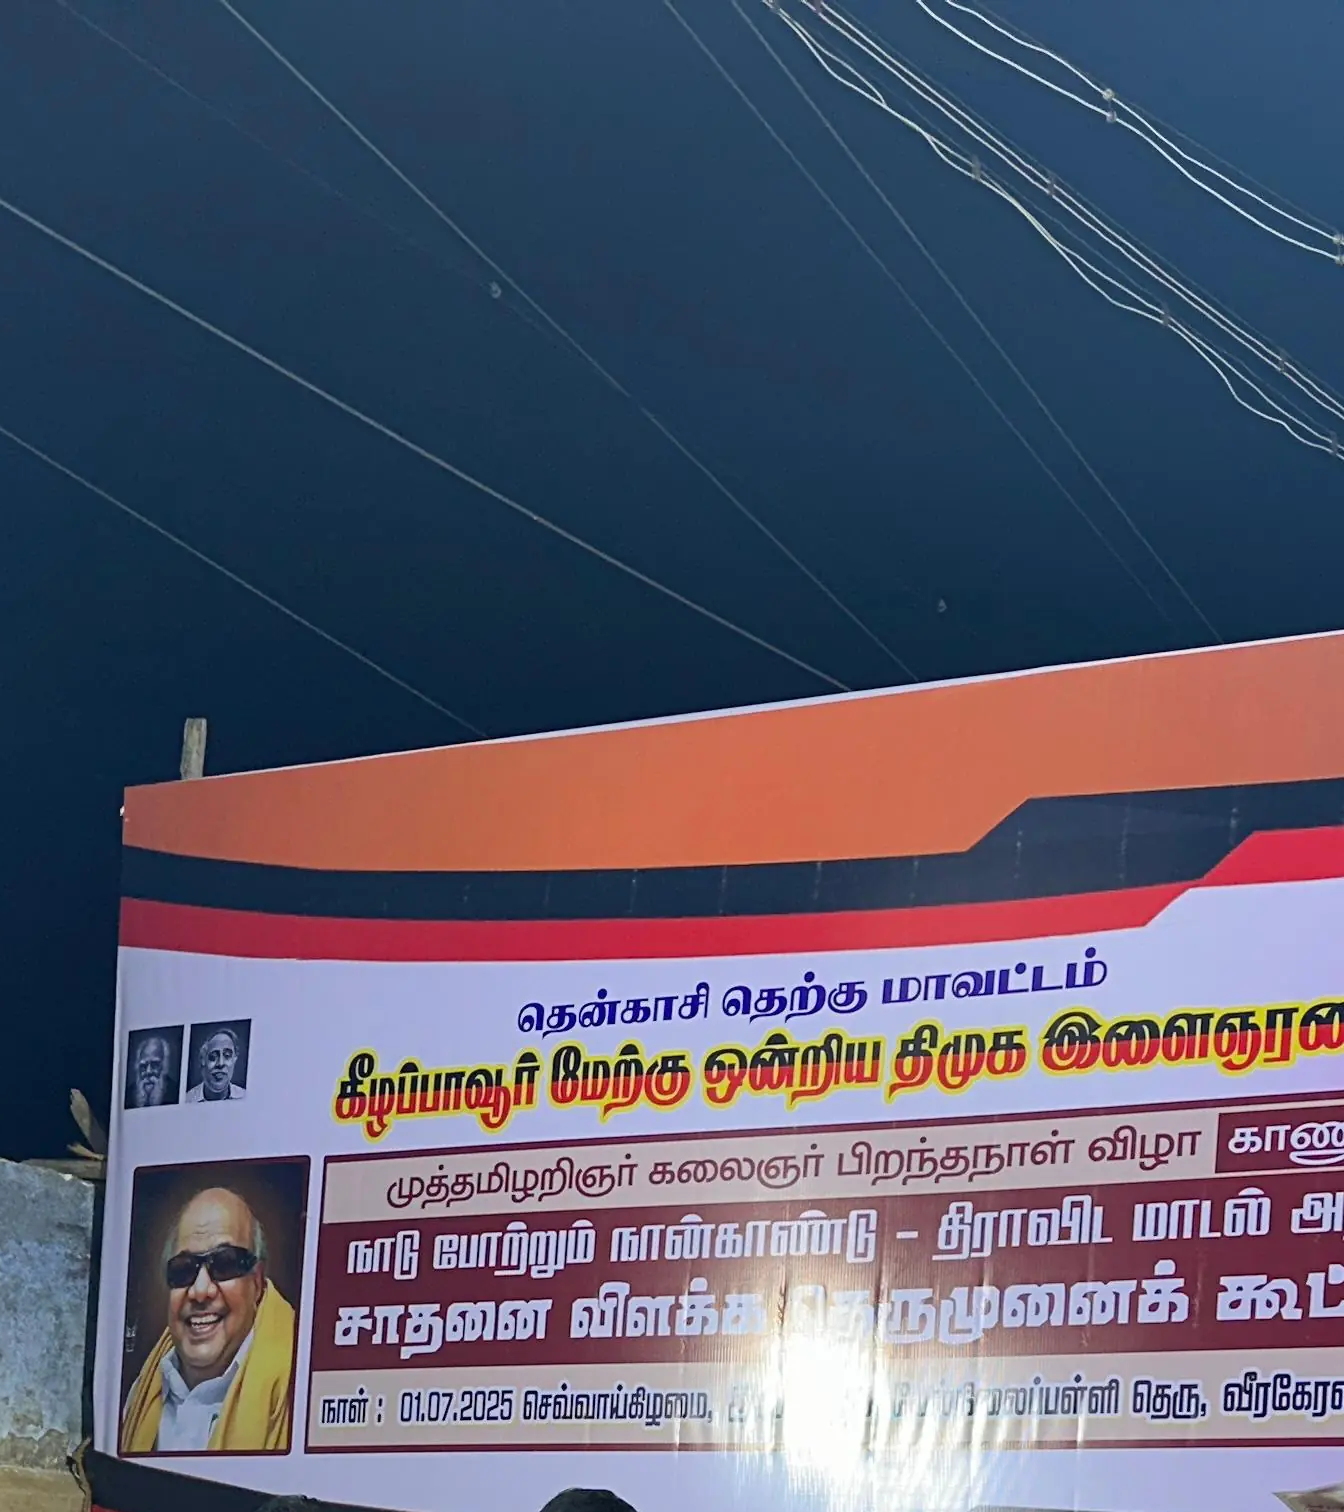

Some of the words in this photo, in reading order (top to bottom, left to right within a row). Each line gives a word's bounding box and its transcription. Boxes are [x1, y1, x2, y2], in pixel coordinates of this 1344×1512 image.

[518, 982, 710, 1039] தென்காசி
[721, 970, 865, 1025] தெற்கு
[882, 947, 1107, 1005] மாவட்டம்
[334, 1050, 540, 1138] கீழப்பாவூர்
[552, 1042, 689, 1119] மேற்கு
[706, 1031, 881, 1104] ஒன்றிய
[889, 1024, 1026, 1098] திமுக
[386, 1152, 635, 1208] முத்தமிழறிஞர்
[649, 1144, 823, 1189] கலைஞர்
[838, 1130, 1075, 1183] பிறந்தநாள்
[1088, 1126, 1202, 1170] விழா
[347, 1229, 421, 1280] நாடு
[432, 1219, 596, 1278] போற்றும்
[609, 1208, 878, 1264] நான்காண்டு
[931, 1193, 1113, 1261] திராவிட
[1132, 1187, 1271, 1241] மாடல்
[334, 1299, 553, 1359] சாதனை
[570, 1276, 768, 1340] விளக்க
[321, 1387, 371, 1425] நாள்
[399, 1390, 513, 1424] 01.07.2025
[1132, 1379, 1207, 1420] தெரு,
